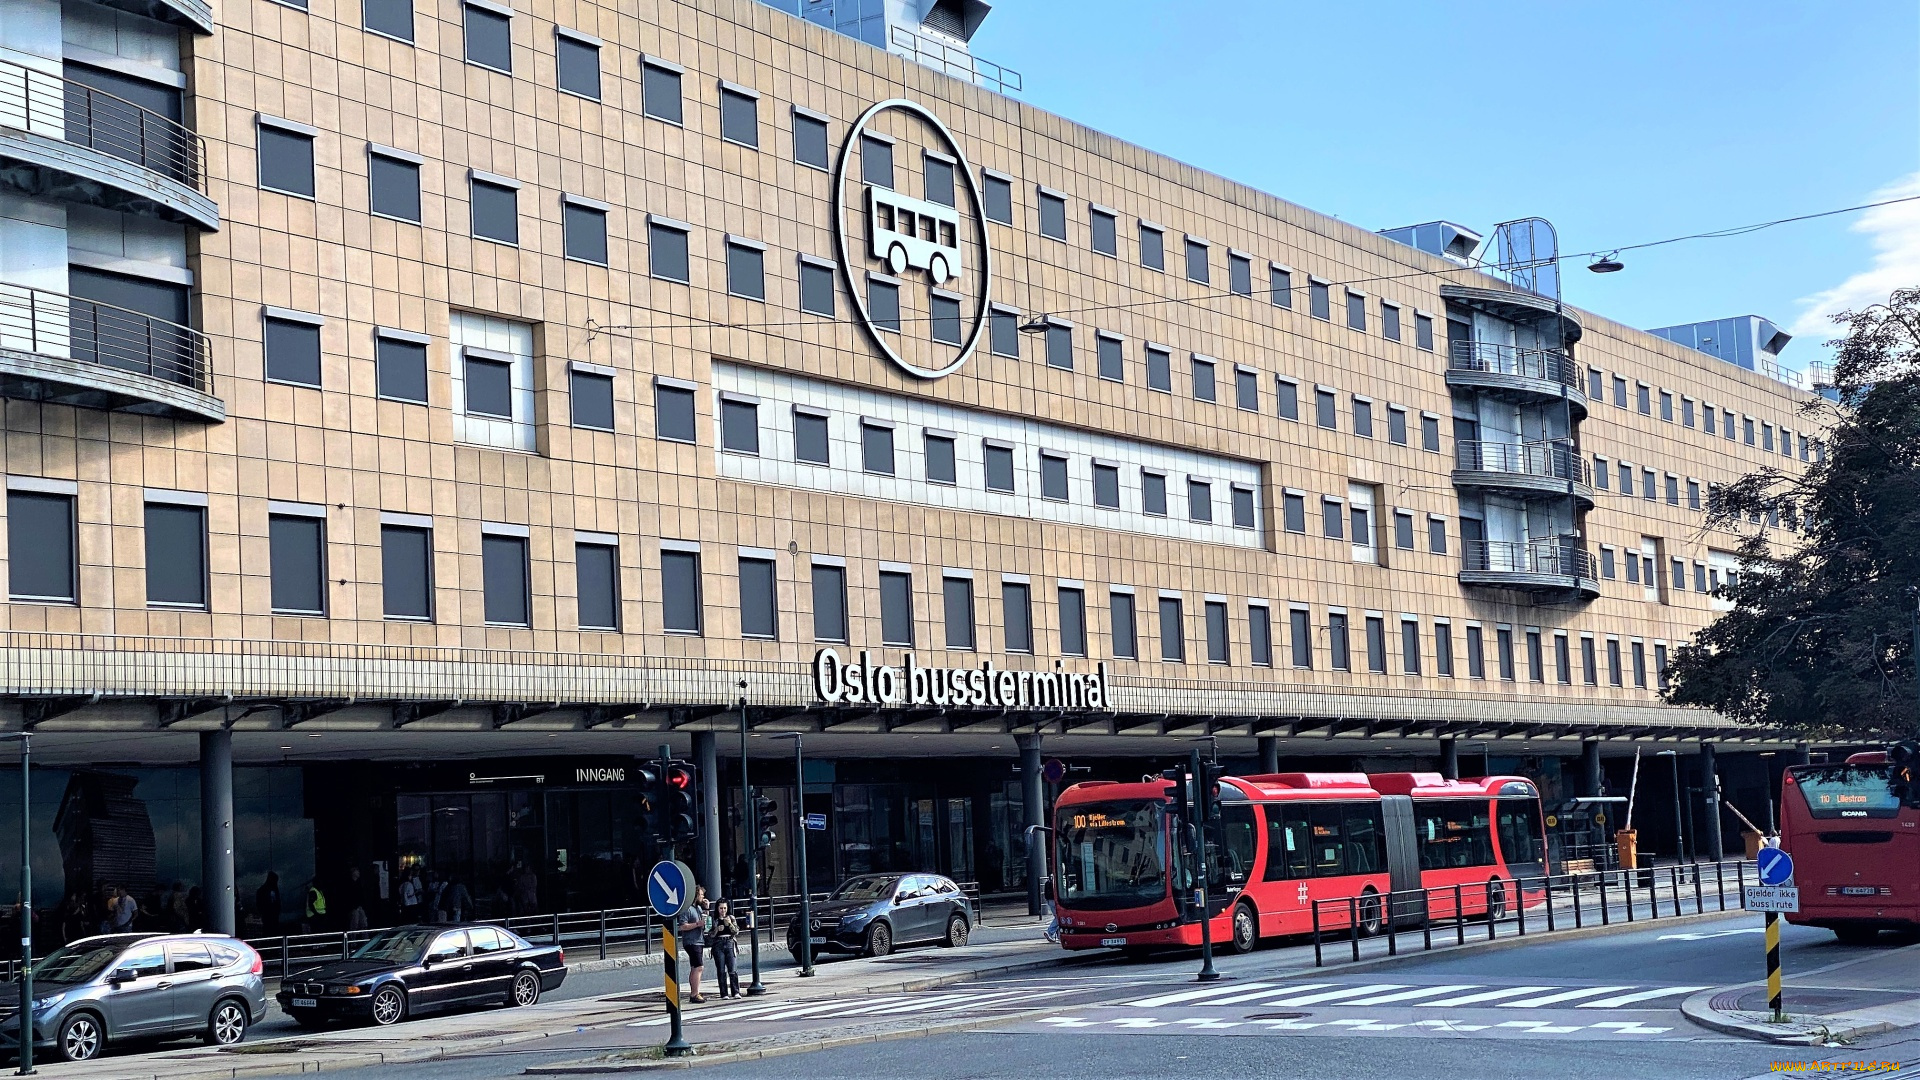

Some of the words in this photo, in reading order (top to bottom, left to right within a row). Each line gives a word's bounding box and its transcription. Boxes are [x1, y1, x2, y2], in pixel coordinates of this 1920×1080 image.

[814, 647, 896, 702] Oslo
[904, 653, 1113, 708] bussterminal
[576, 768, 625, 781] INNGANG
[1821, 795, 1830, 803] 110
[1074, 815, 1086, 828] 100
[1747, 888, 1775, 899] Gjelder
[1779, 889, 1796, 898] ikke
[1750, 900, 1770, 908] buss
[1771, 900, 1774, 908] i
[1776, 901, 1793, 909] rute
